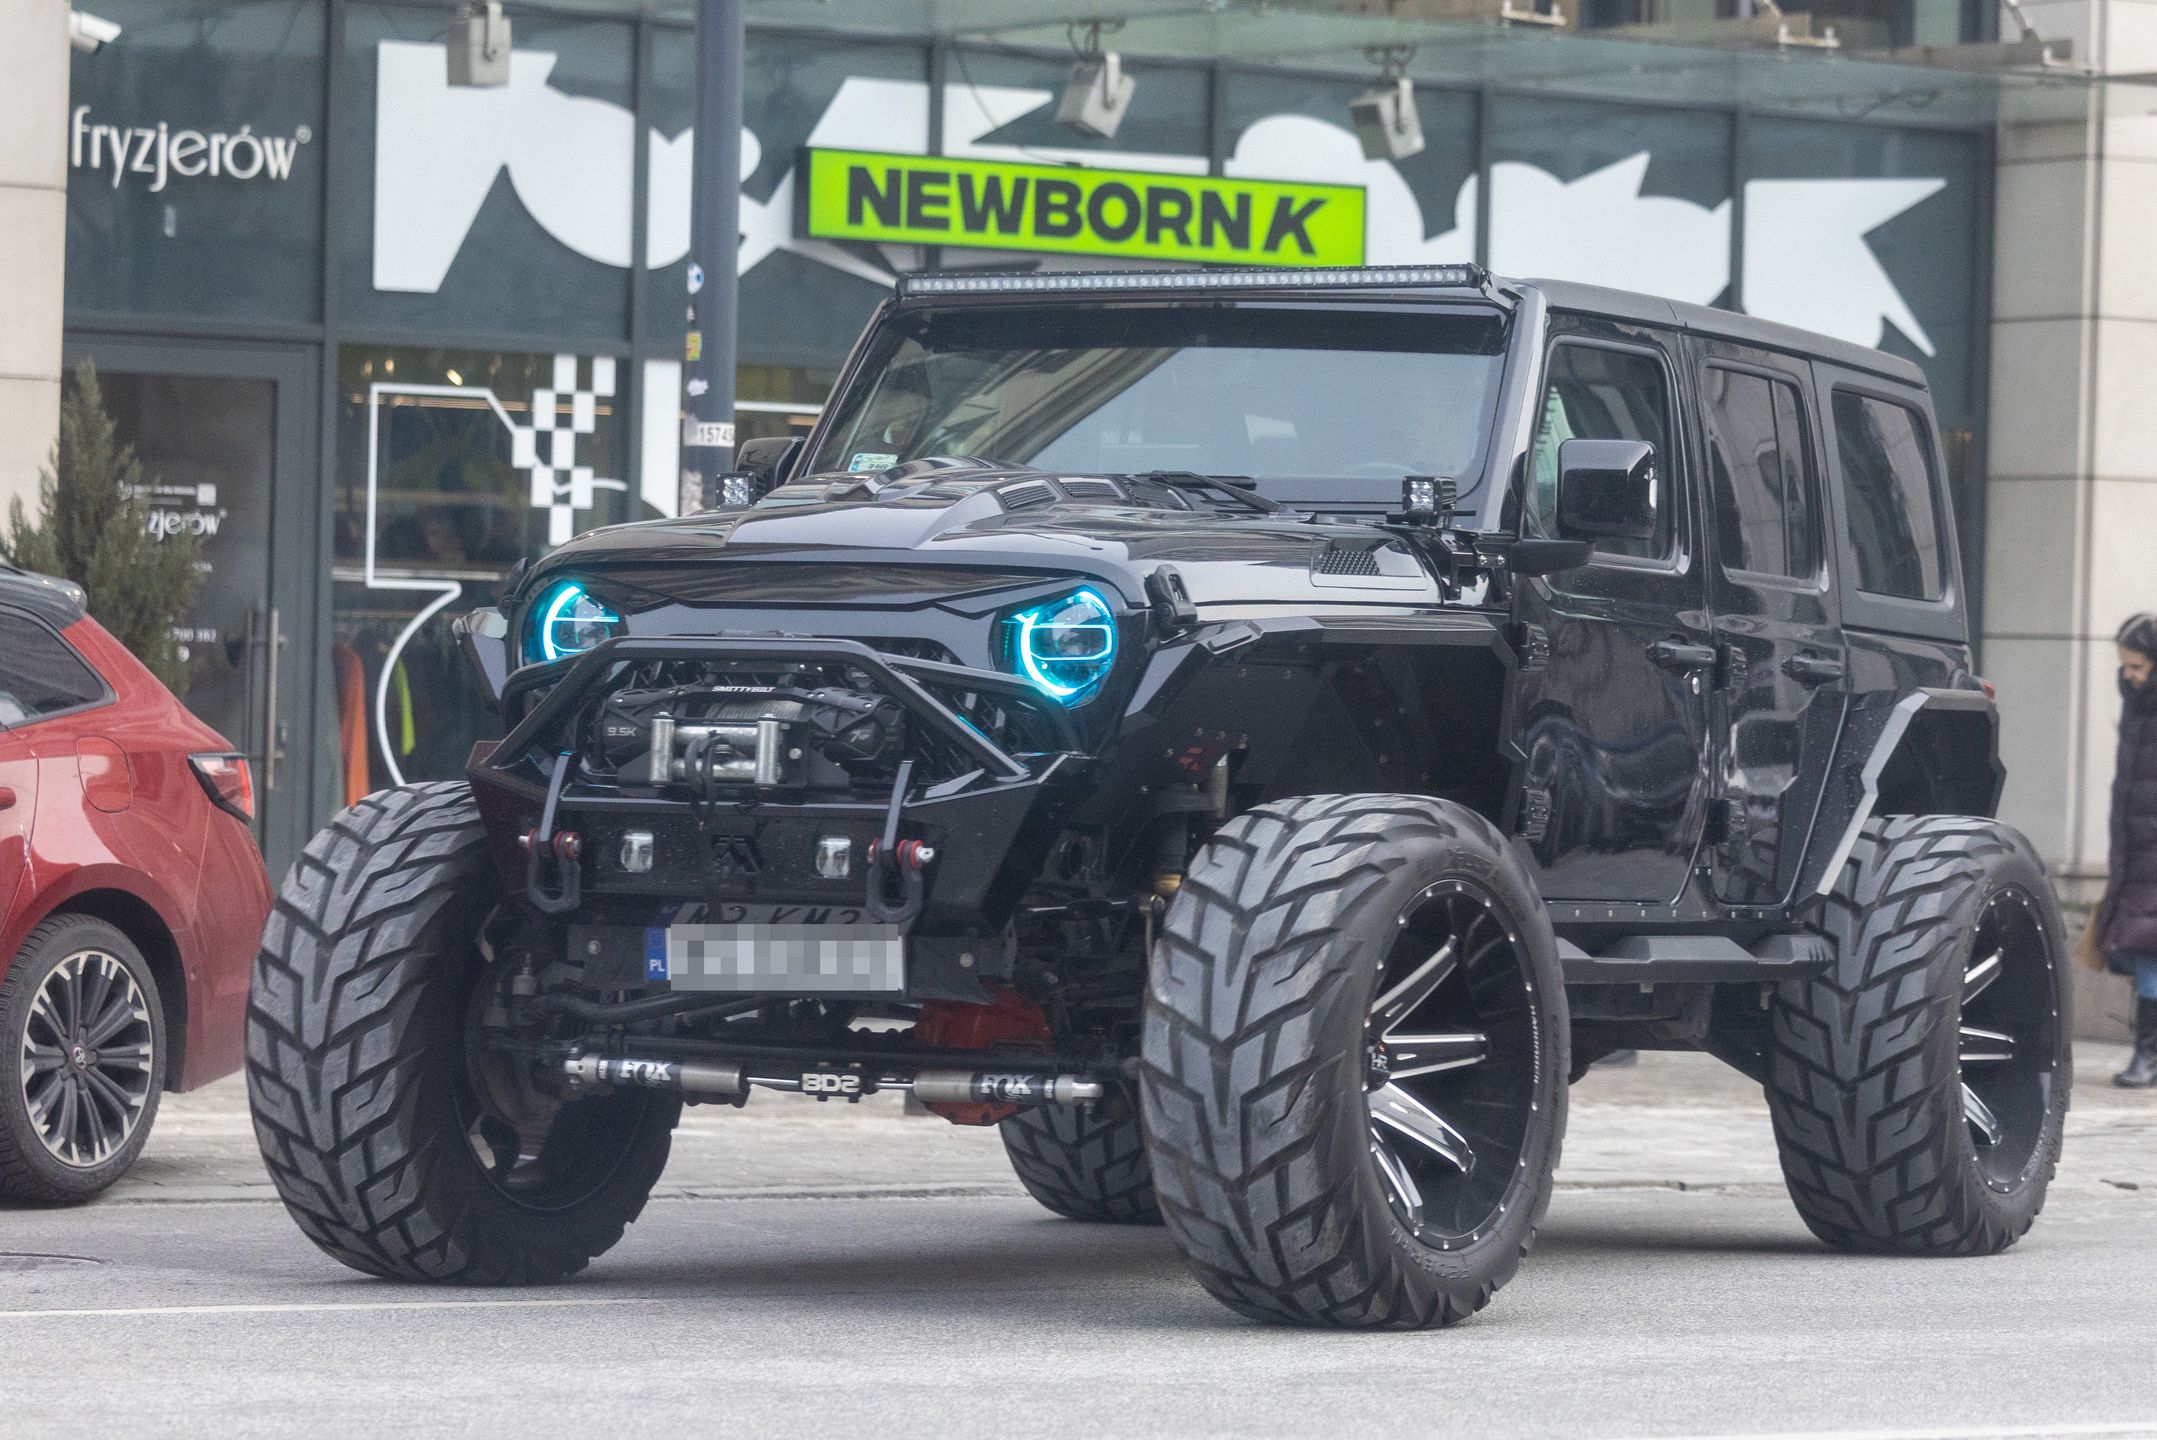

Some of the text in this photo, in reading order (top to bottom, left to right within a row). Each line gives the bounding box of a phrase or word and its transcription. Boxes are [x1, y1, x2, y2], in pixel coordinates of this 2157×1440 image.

[846, 165, 1329, 256] NEWBORN K
[649, 959, 666, 973] PL
[619, 1059, 672, 1082] FOX
[979, 1073, 1034, 1095] FOX
